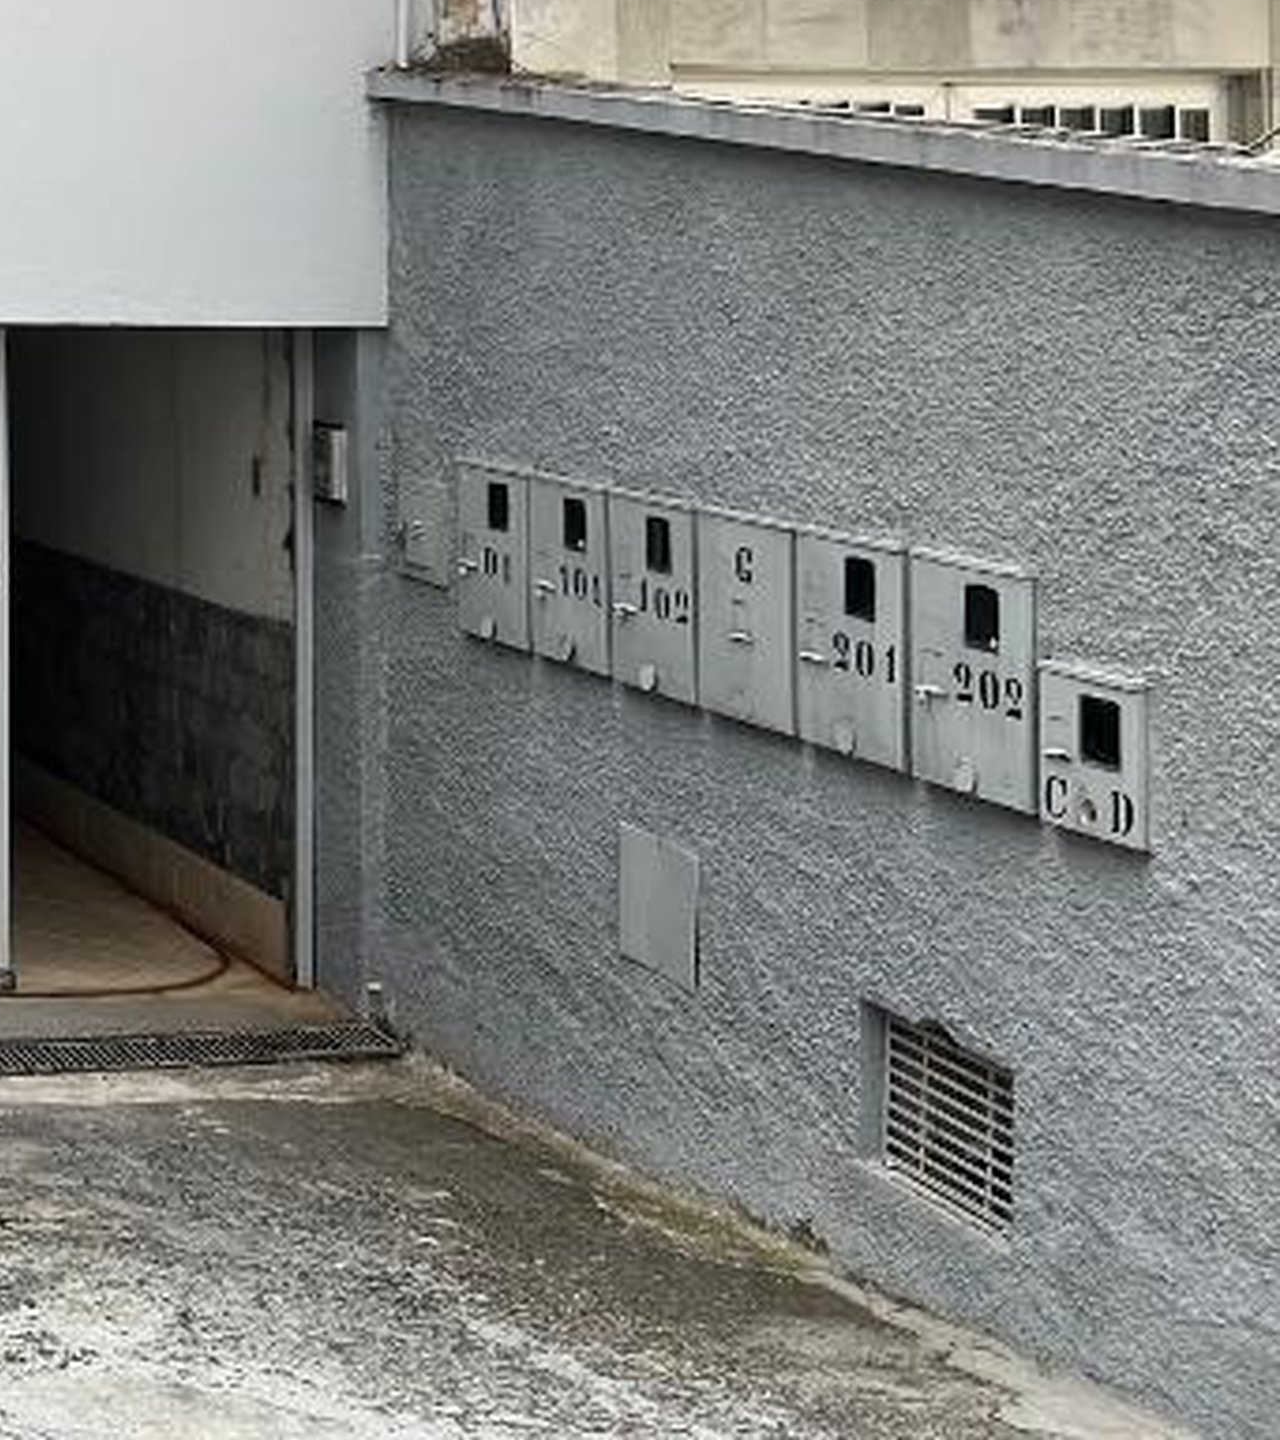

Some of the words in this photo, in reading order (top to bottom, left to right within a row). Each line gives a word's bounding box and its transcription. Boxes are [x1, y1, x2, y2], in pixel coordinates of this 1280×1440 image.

[833, 632, 896, 684] 201
[953, 662, 1023, 720] 202
[1045, 775, 1068, 819] C
[1110, 790, 1135, 837] D
